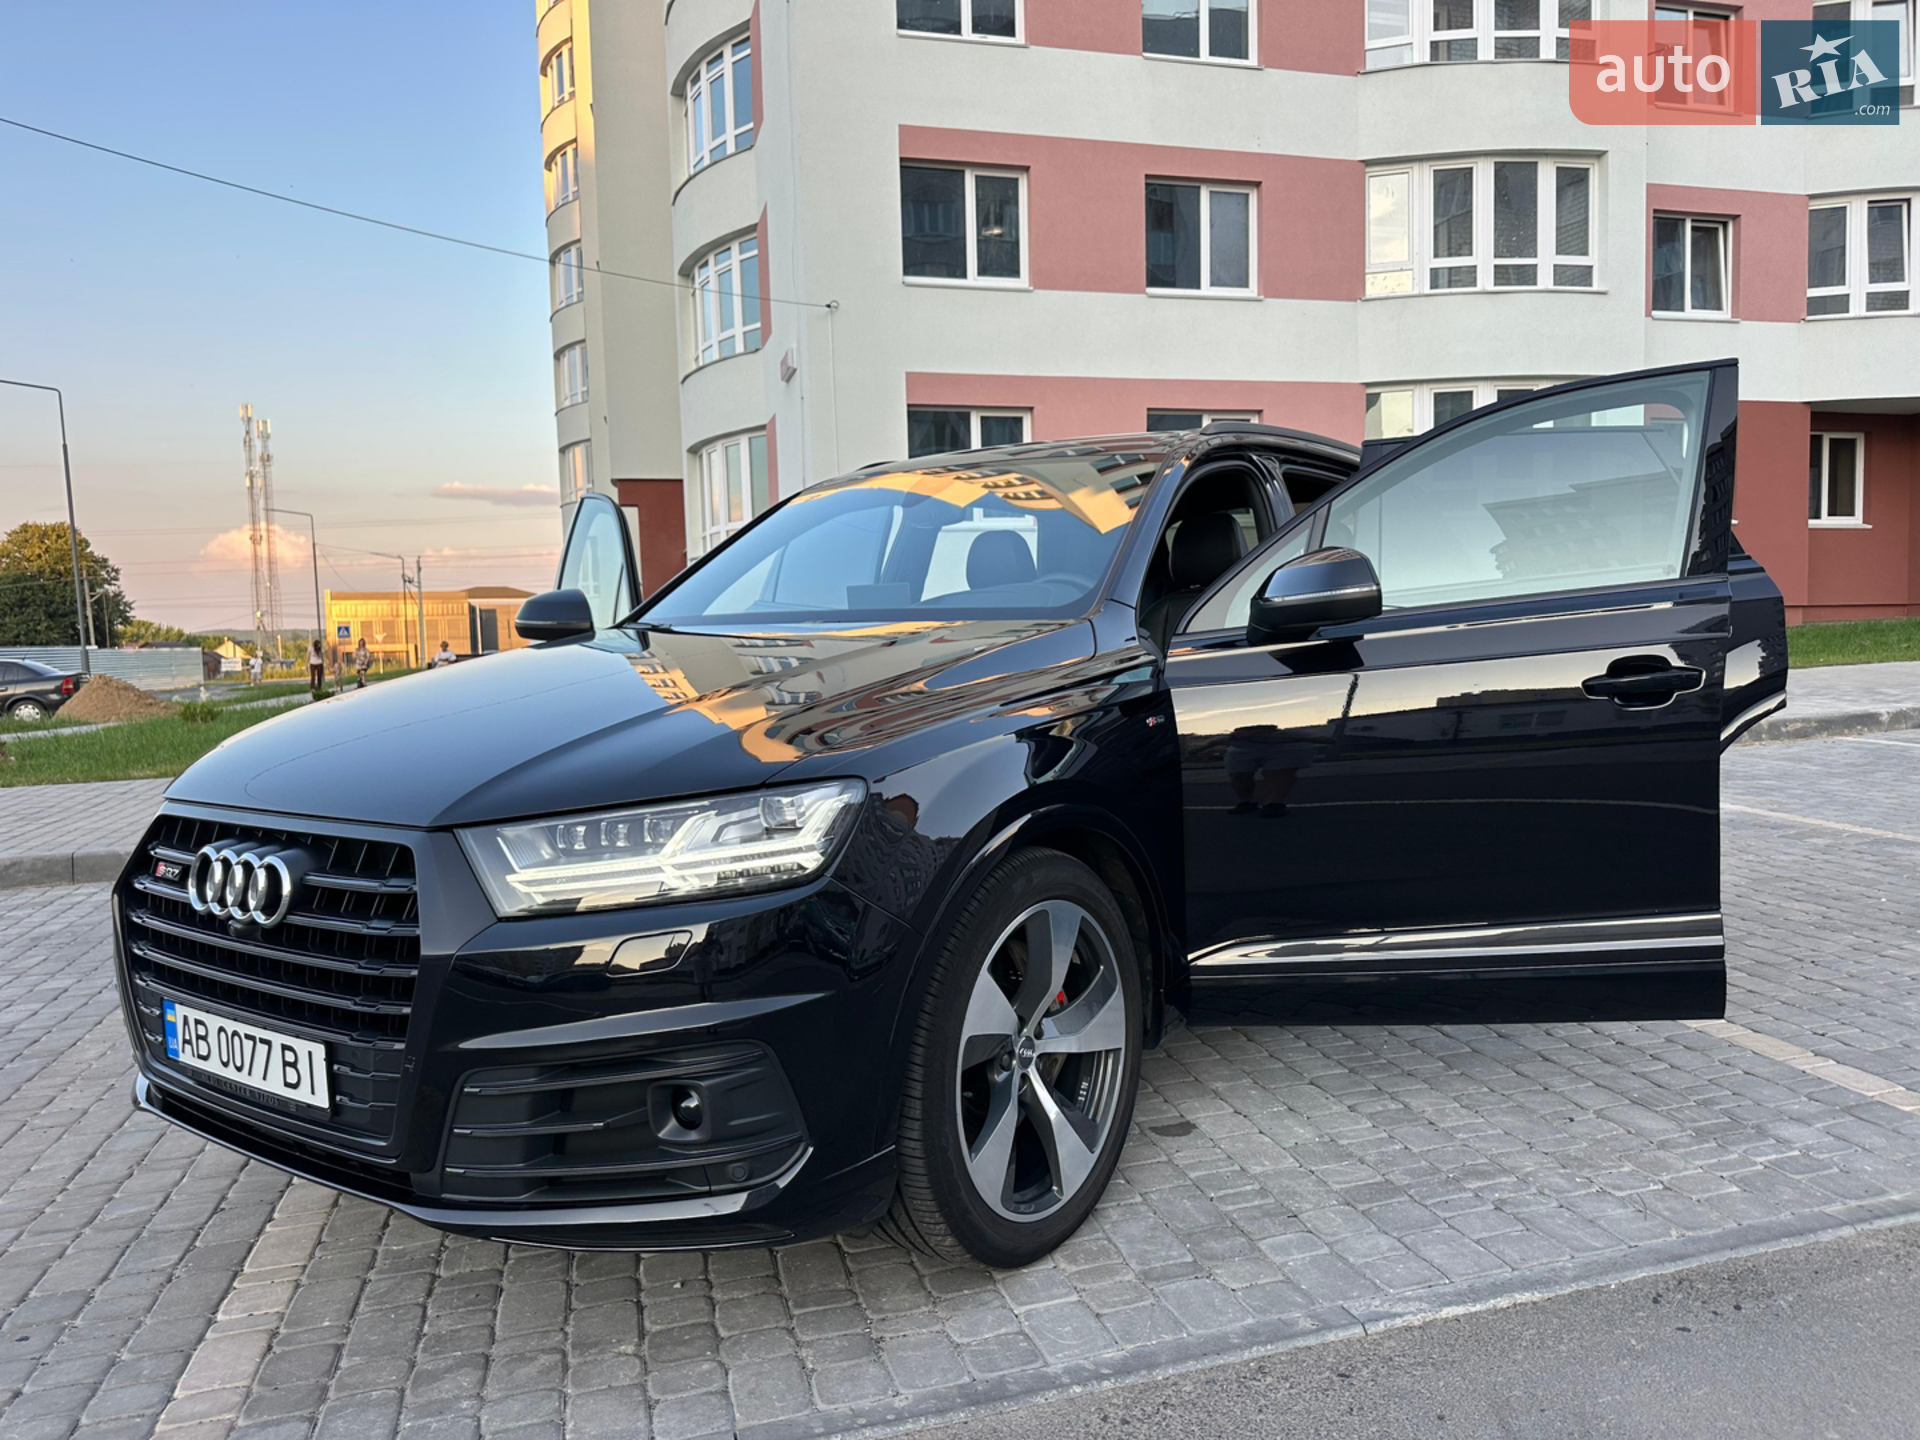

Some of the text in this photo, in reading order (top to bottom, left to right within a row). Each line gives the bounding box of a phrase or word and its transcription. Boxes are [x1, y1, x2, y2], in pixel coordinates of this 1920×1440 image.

[181, 1014, 316, 1096] AB 0077 BI
